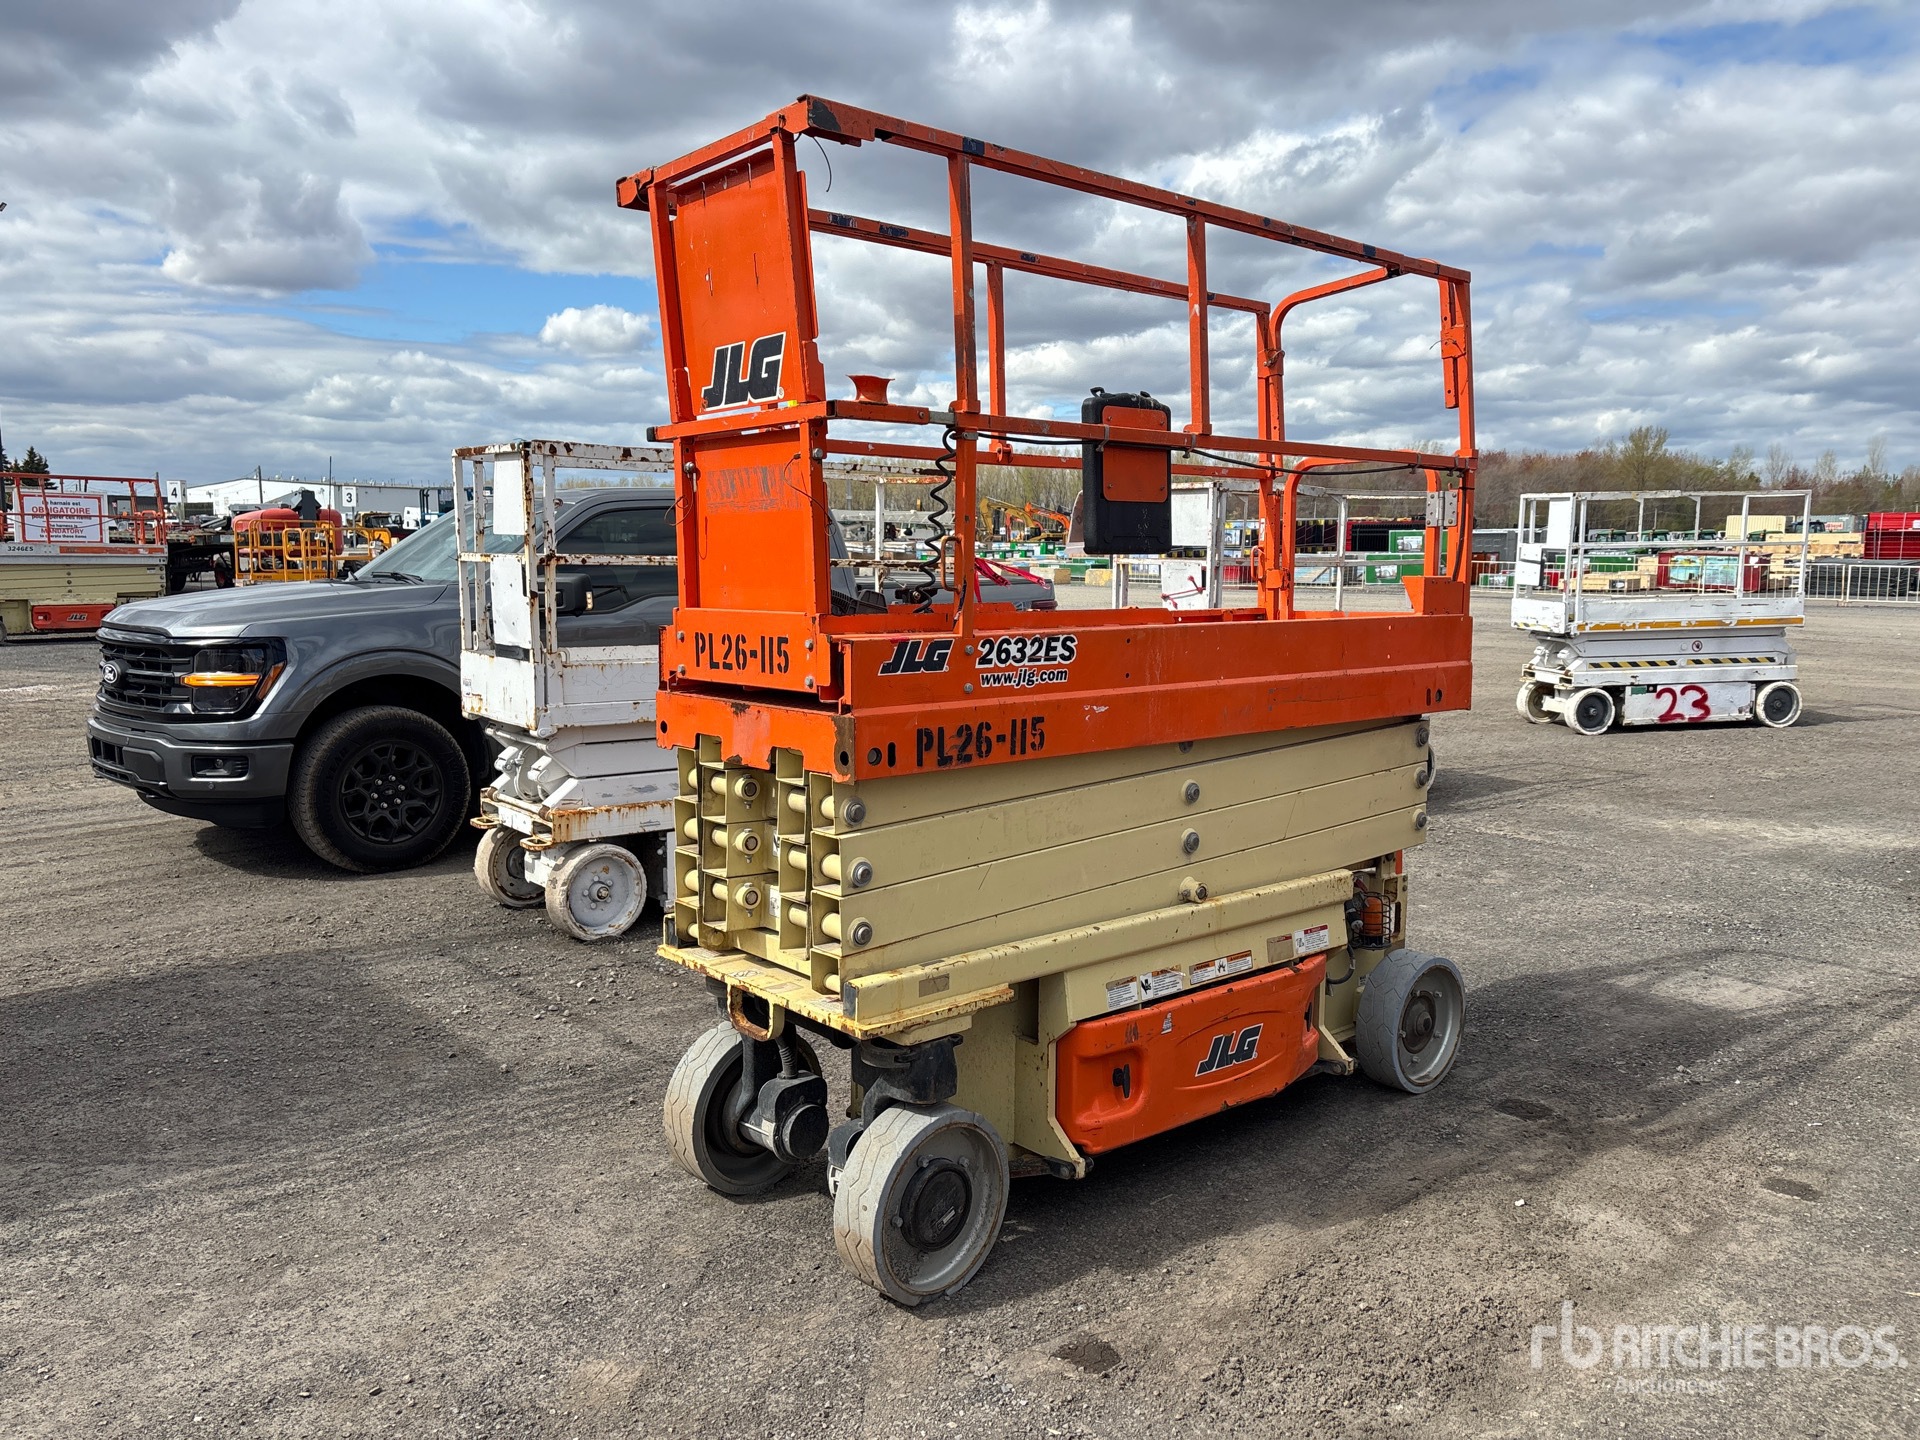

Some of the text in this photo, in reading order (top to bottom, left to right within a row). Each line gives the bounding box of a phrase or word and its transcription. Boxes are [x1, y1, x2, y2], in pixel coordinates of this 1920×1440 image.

[702, 332, 785, 410] JLG
[31, 506, 91, 514] OBIGATOIRE
[171, 487, 178, 498] 4
[346, 492, 353, 503] 3
[67, 613, 88, 621] JLG
[694, 631, 789, 675] PL26-115
[879, 638, 954, 675] JLG
[976, 634, 1078, 668] 2632ES
[979, 668, 1069, 688] www.jlg.com
[1655, 684, 1711, 723] 23
[916, 716, 1045, 768] PL26-115
[1195, 1023, 1263, 1077] JLG
